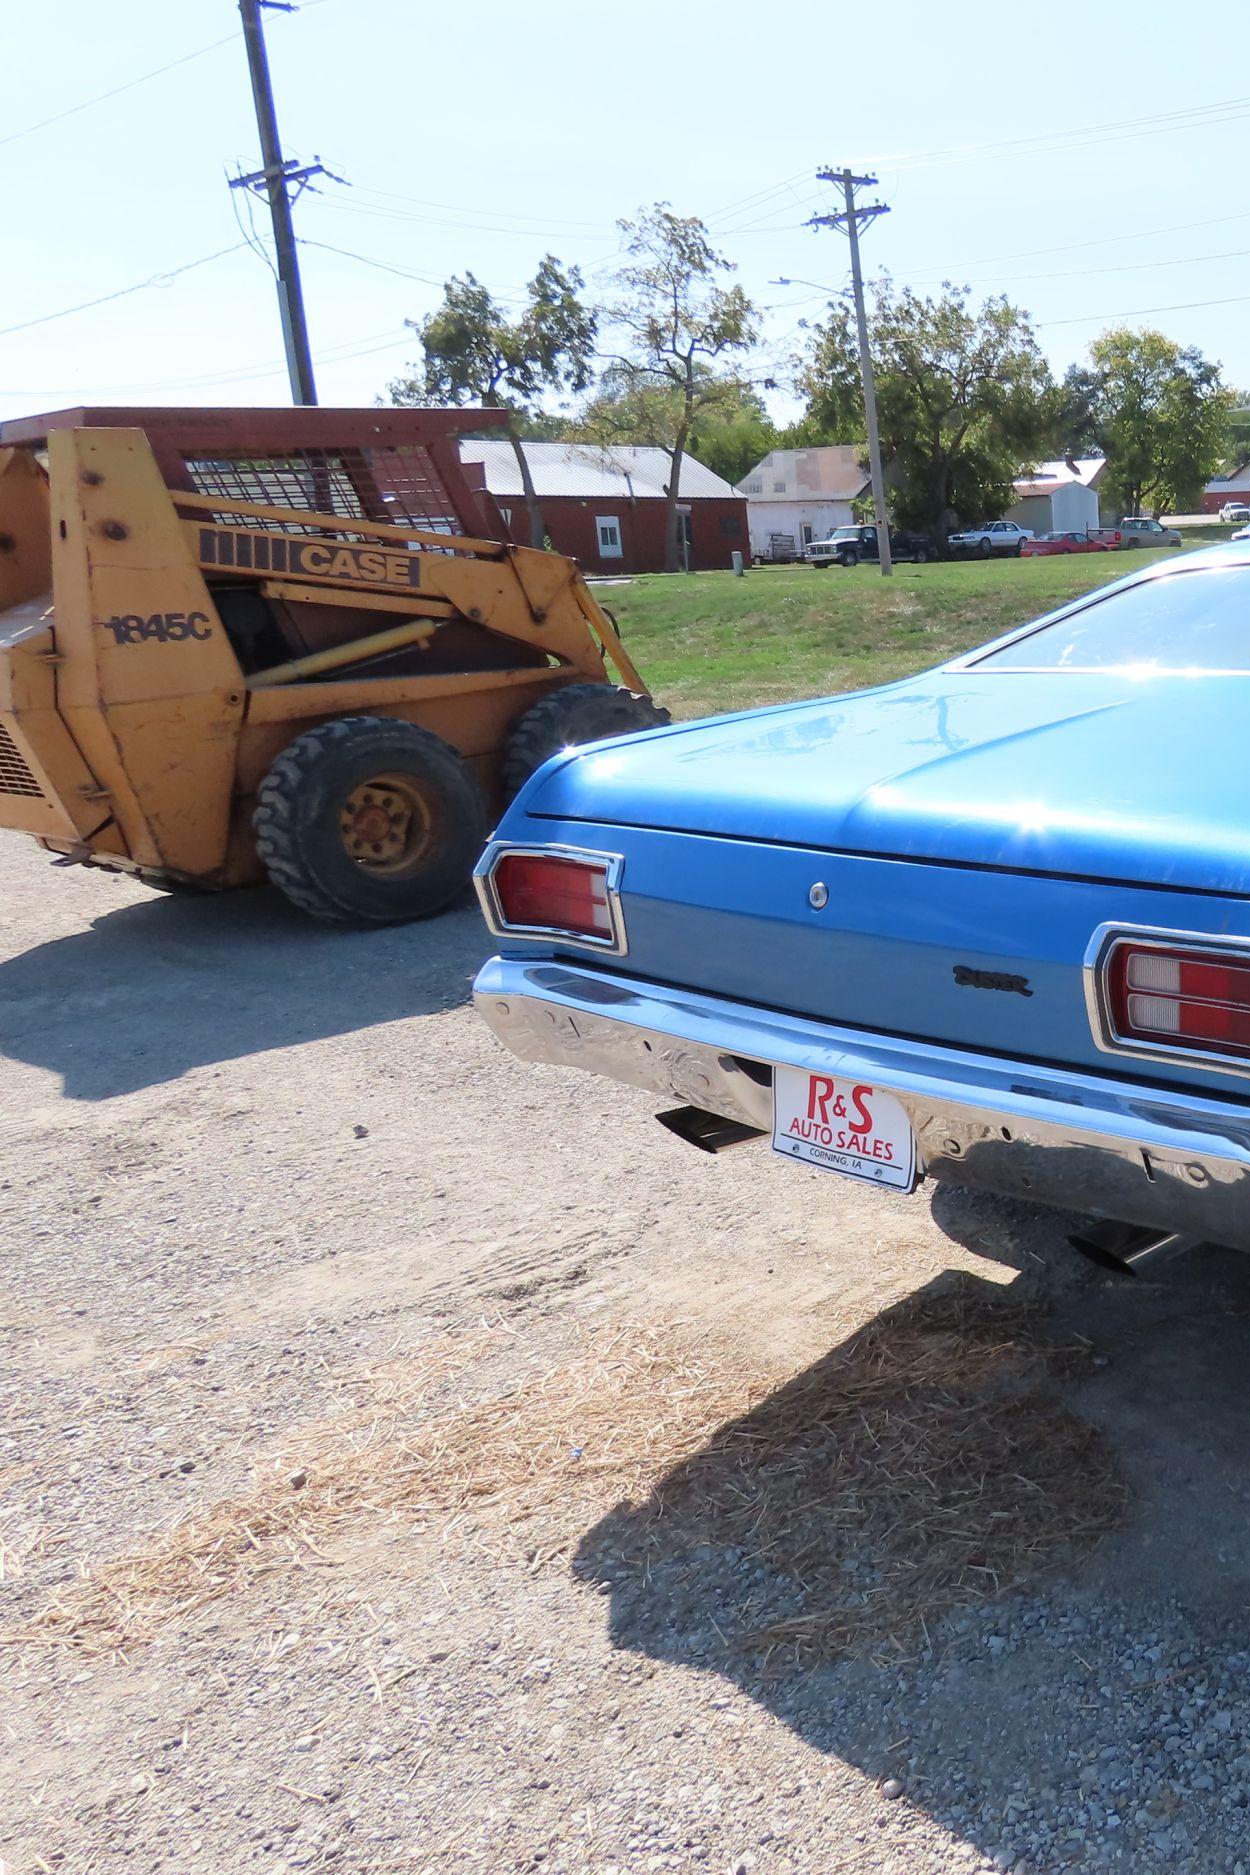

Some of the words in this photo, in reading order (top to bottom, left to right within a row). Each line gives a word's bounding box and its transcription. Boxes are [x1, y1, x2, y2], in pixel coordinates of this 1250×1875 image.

[300, 545, 411, 584] CASE
[104, 611, 213, 645] 1845C
[789, 1117, 833, 1145] AUTO
[836, 1131, 893, 1161] SALES
[809, 1147, 849, 1167] CORNING,
[852, 1159, 862, 1170] IA
